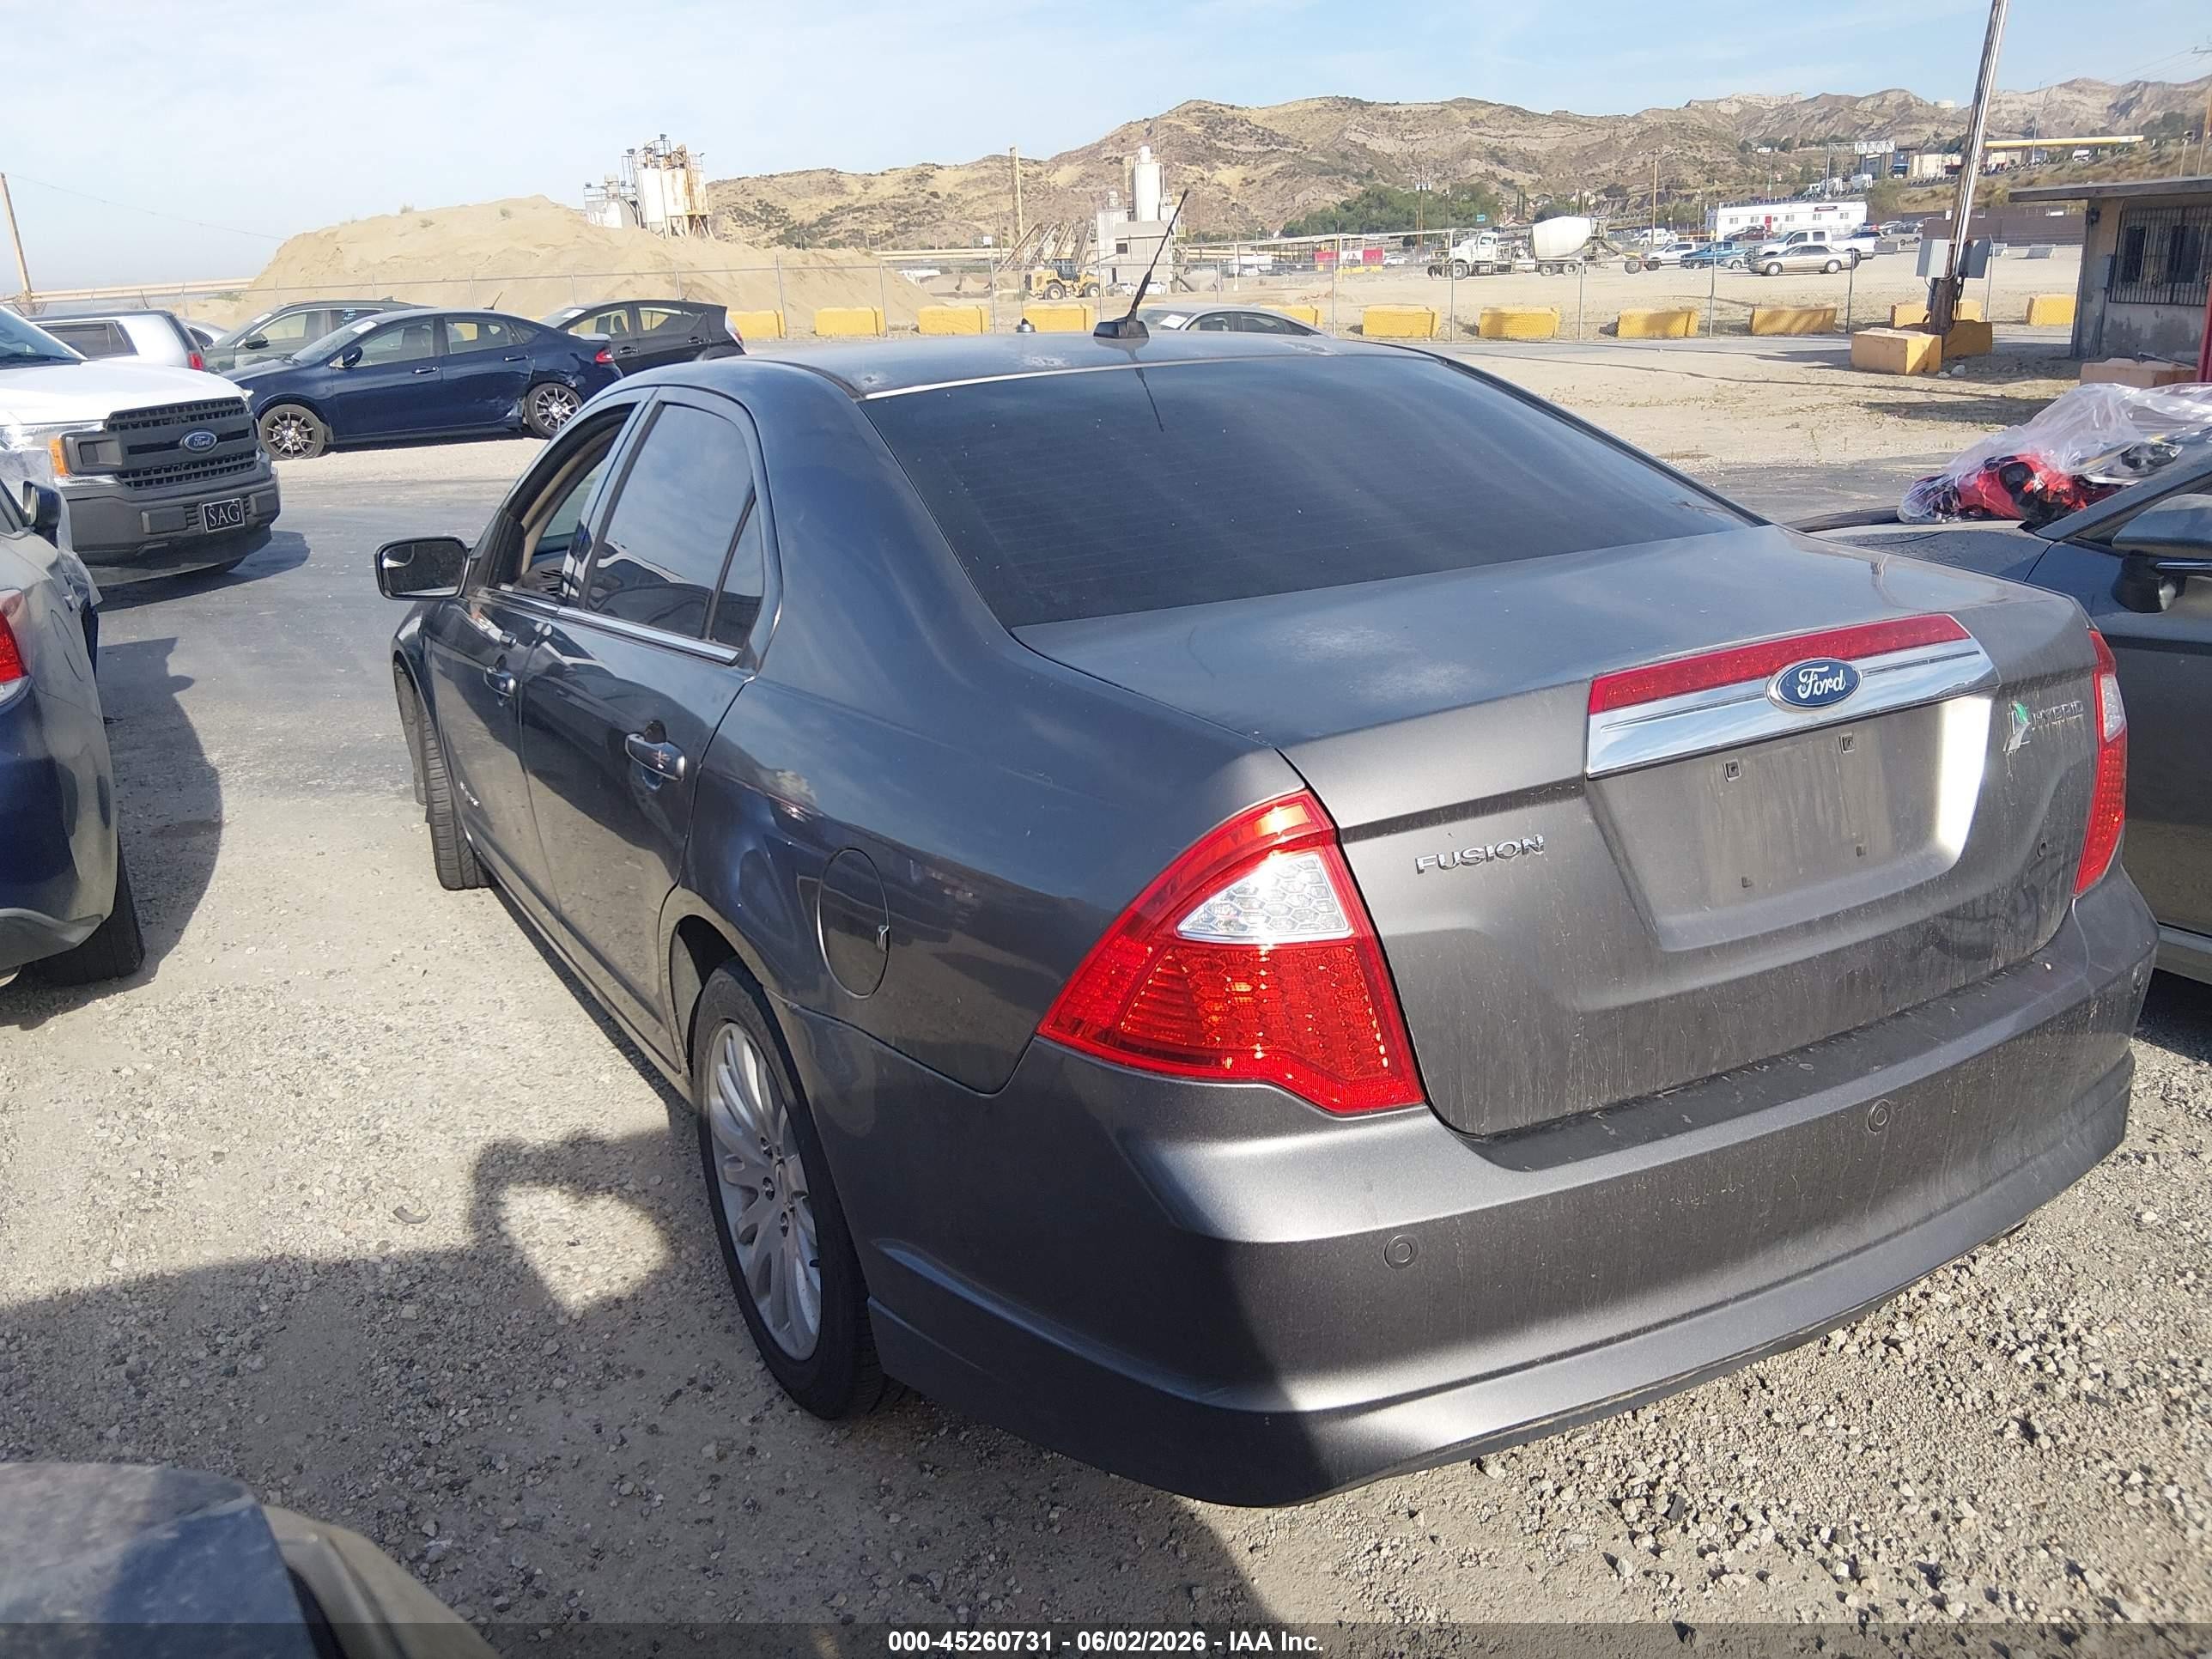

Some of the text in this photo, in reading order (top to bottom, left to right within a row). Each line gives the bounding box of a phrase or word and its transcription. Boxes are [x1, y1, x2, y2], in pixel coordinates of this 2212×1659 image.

[208, 503, 240, 526] SAG
[1797, 665, 1846, 699] Ford
[1415, 834, 1545, 875] FUSION
